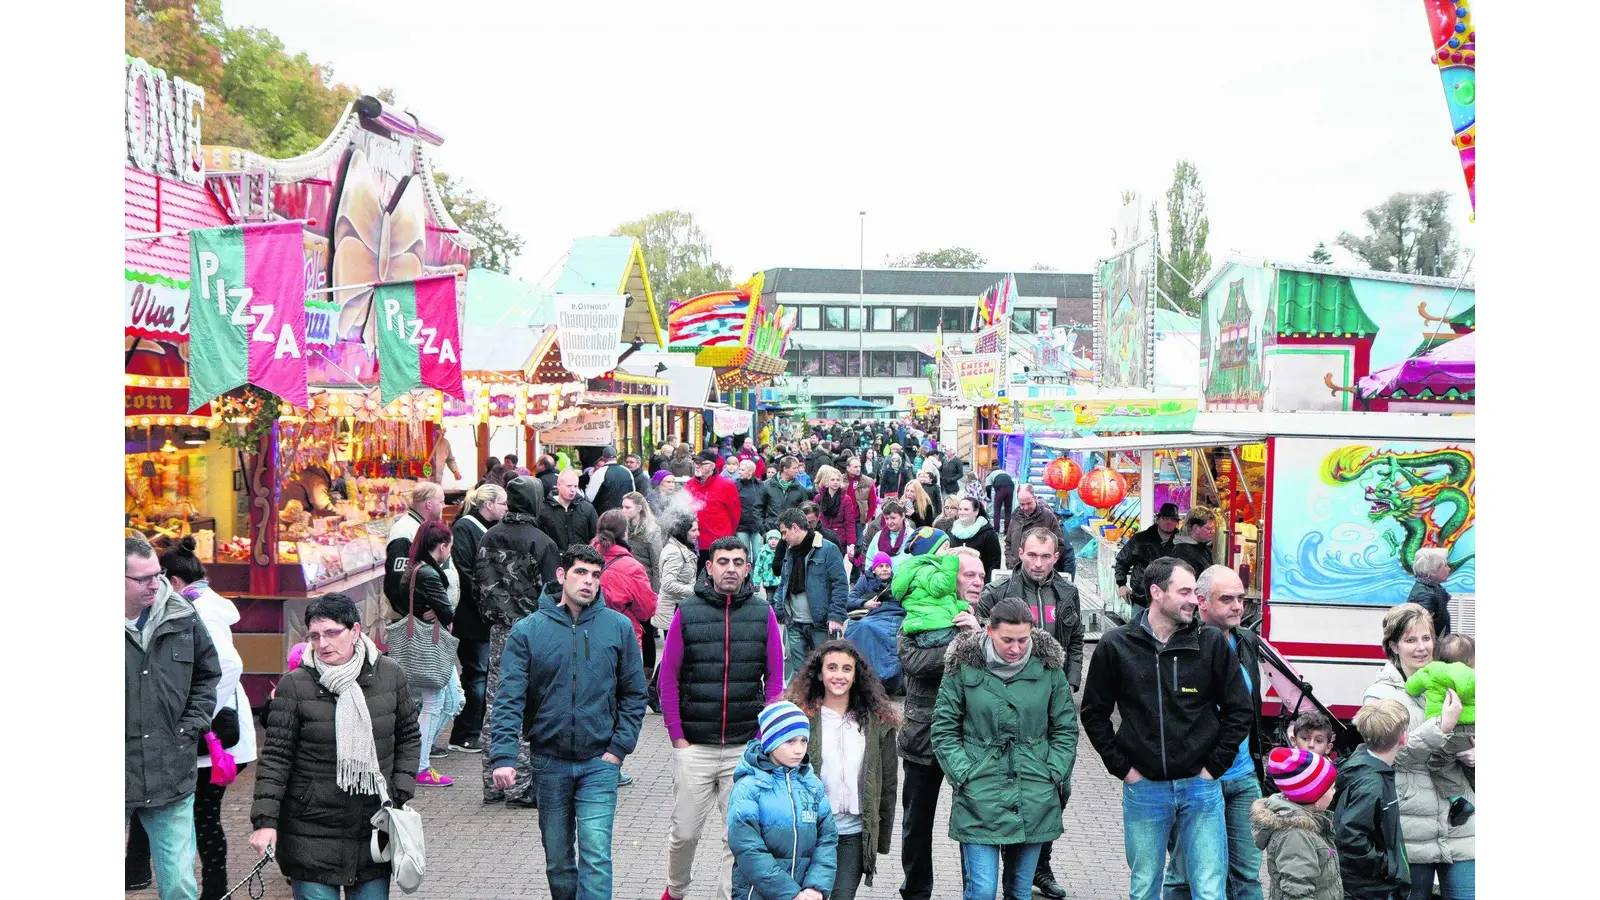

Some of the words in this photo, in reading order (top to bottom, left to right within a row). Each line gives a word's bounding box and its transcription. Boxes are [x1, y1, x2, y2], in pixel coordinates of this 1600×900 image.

[125, 57, 205, 187] ONE
[131, 284, 175, 327] Viva
[199, 251, 301, 360] PIZZA
[560, 311, 619, 331] Champignons
[384, 299, 457, 364] PIZZA
[562, 332, 617, 350] Blumenkohl
[567, 352, 612, 367] Pommes
[961, 363, 990, 371] ENTEN
